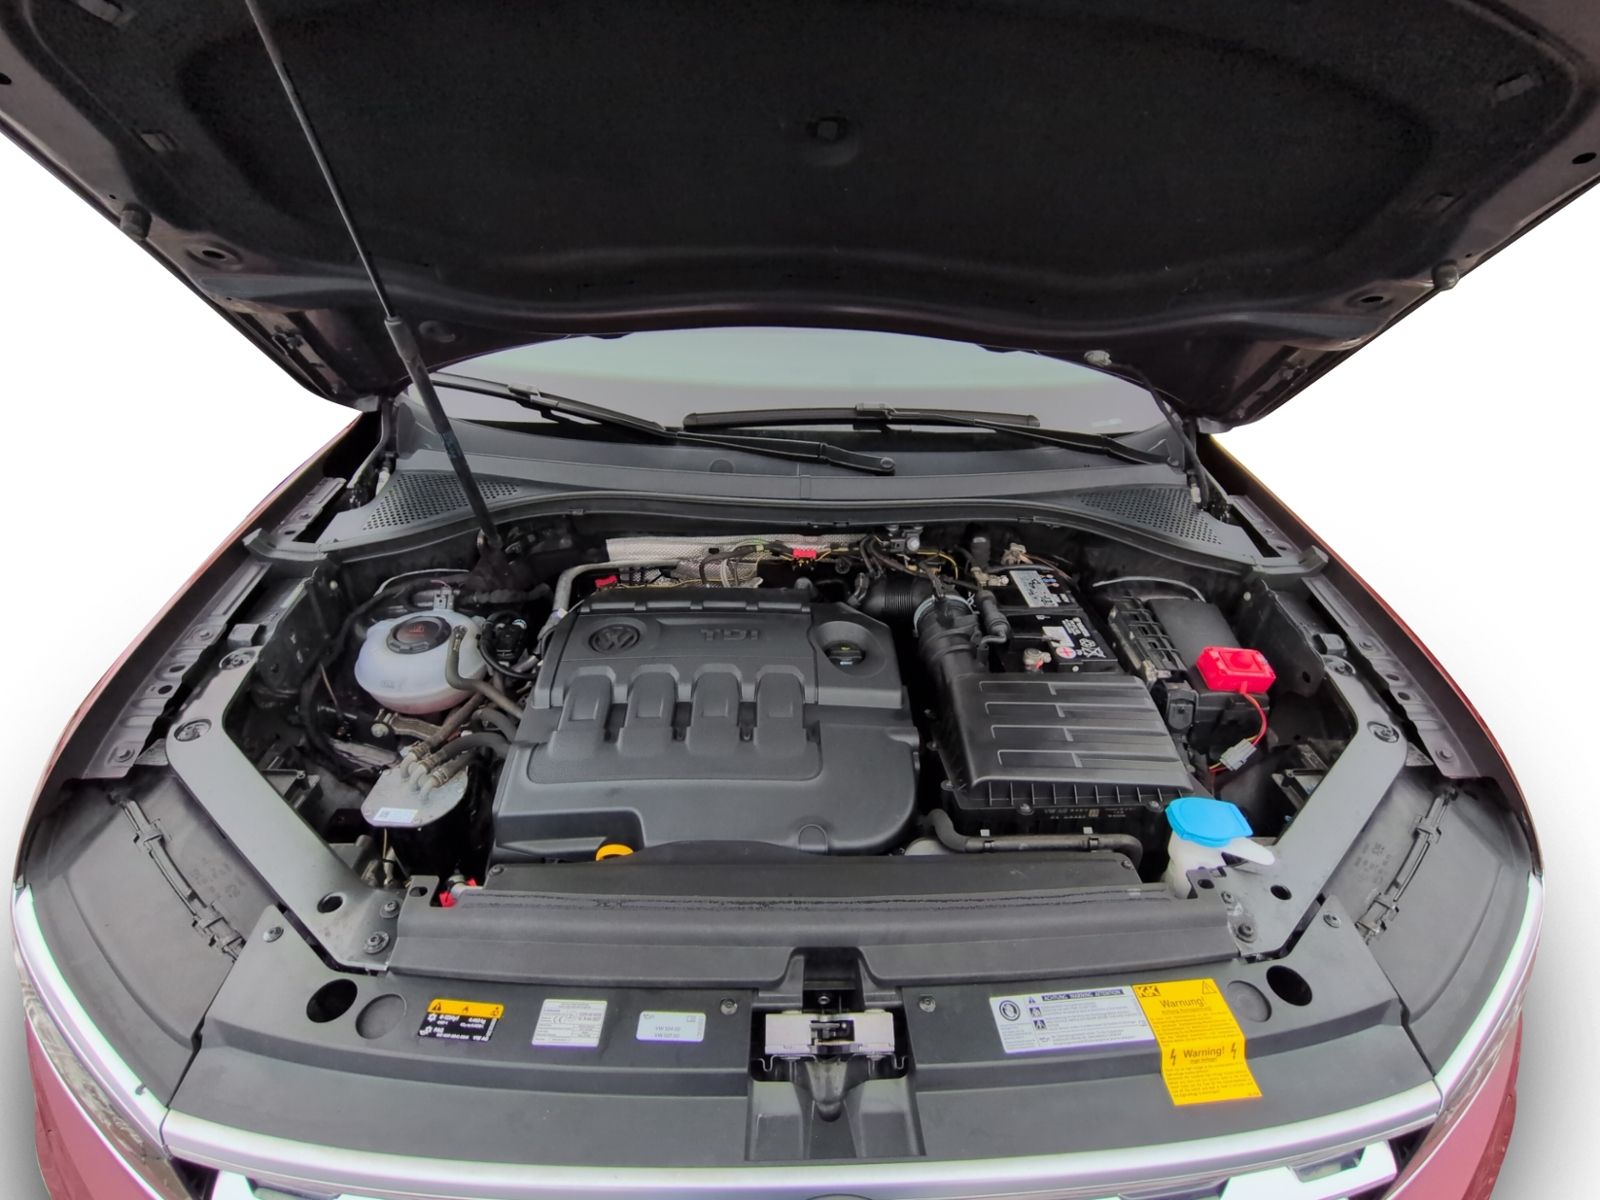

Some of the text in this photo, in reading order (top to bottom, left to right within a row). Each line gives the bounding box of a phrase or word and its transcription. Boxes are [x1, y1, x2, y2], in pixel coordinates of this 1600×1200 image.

[701, 628, 760, 641] TDI
[1160, 995, 1205, 1008] Warnung!
[1184, 1046, 1224, 1058] Warning!
